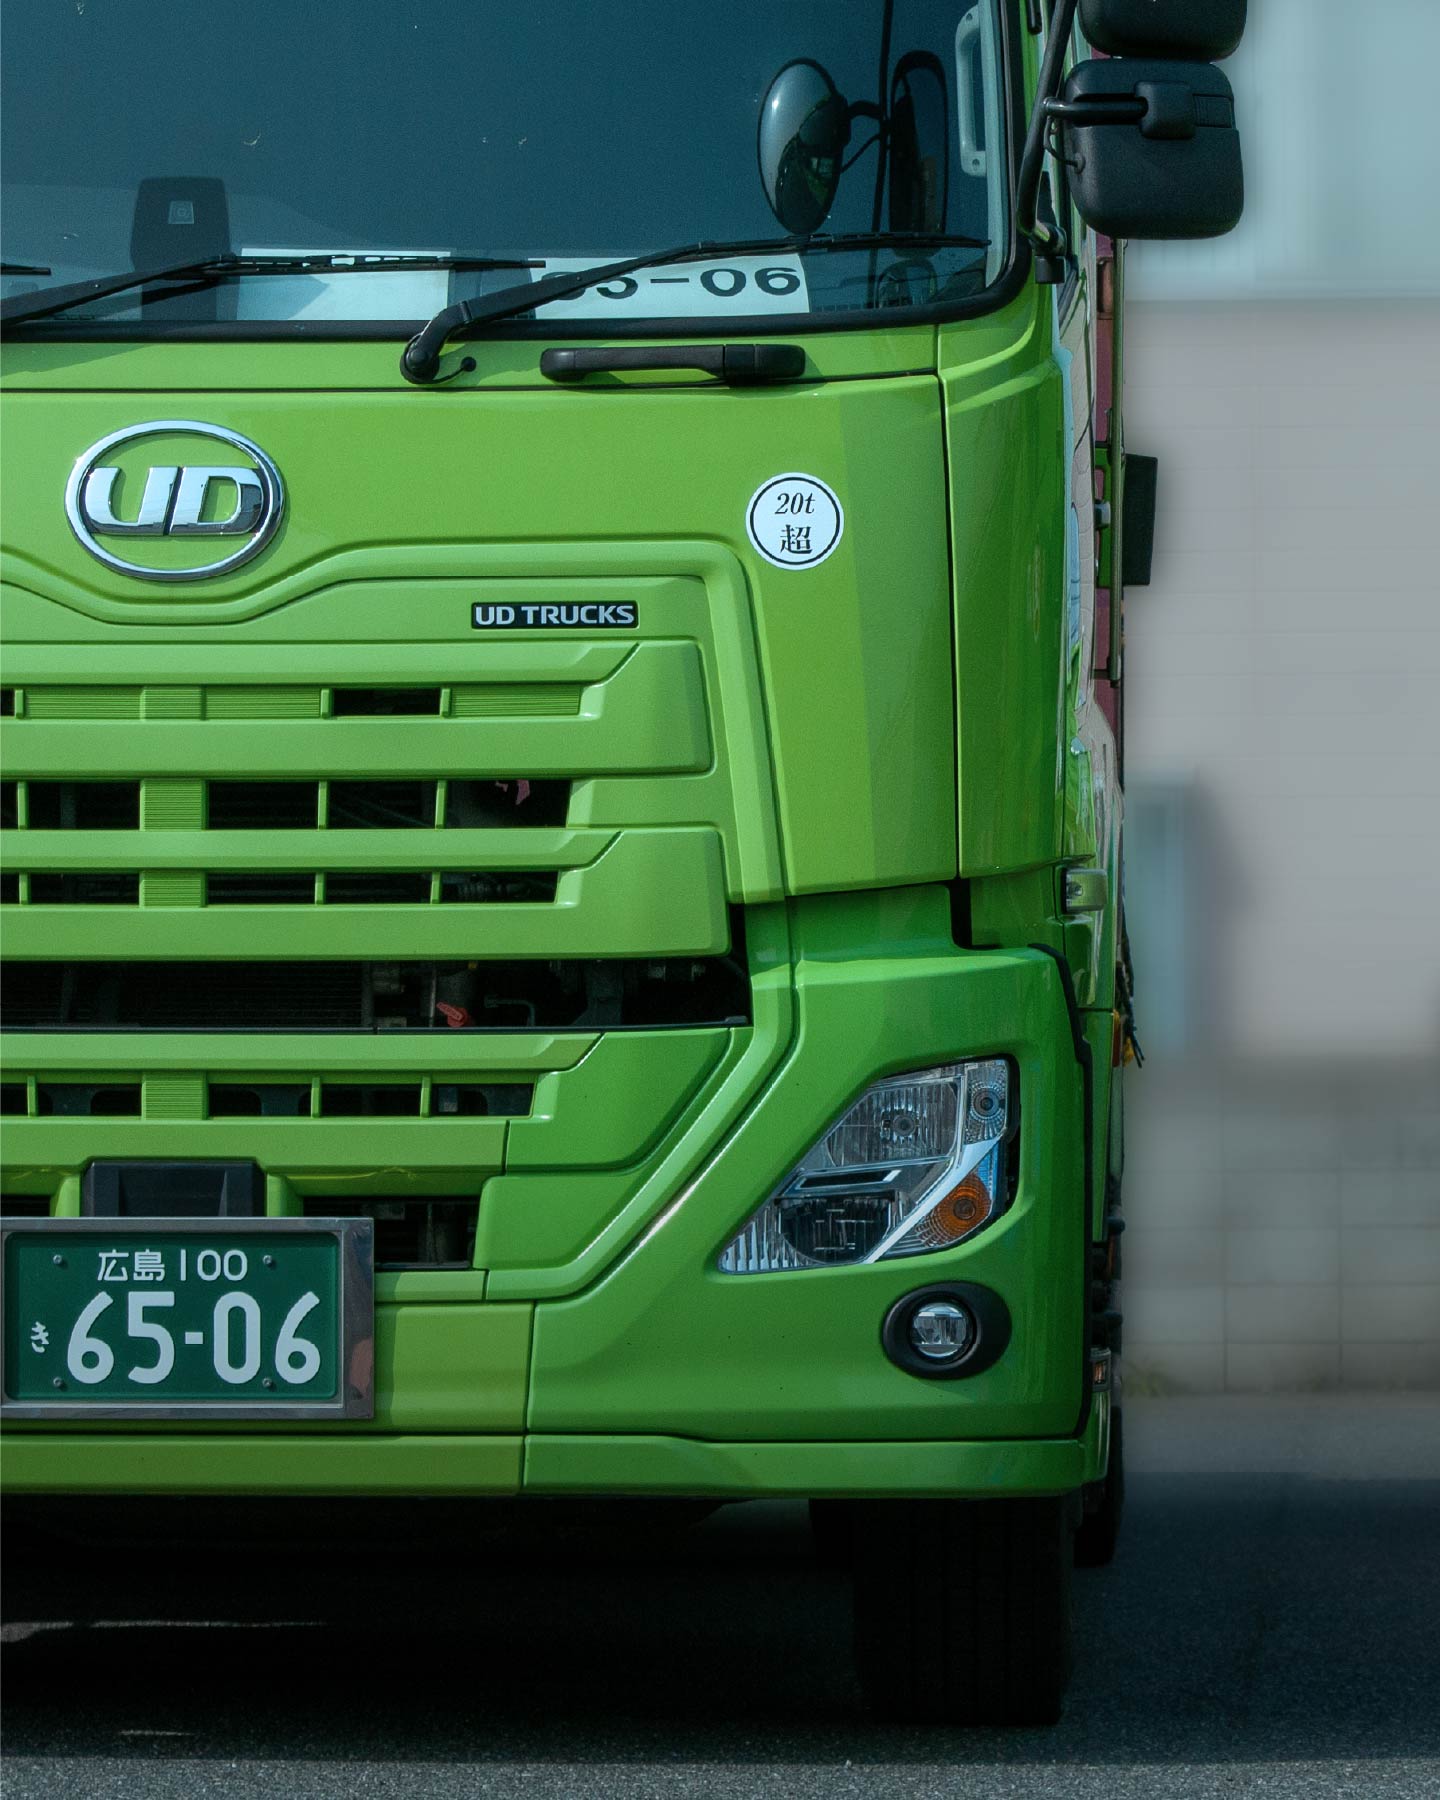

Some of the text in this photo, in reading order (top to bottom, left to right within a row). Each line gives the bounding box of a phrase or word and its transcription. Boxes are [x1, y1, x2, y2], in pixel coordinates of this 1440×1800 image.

[84, 466, 264, 536] UD
[774, 492, 816, 515] 20t
[779, 524, 813, 554] 超
[475, 605, 635, 625] UD TRUCKS
[30, 1290, 321, 1385] き 65-06
